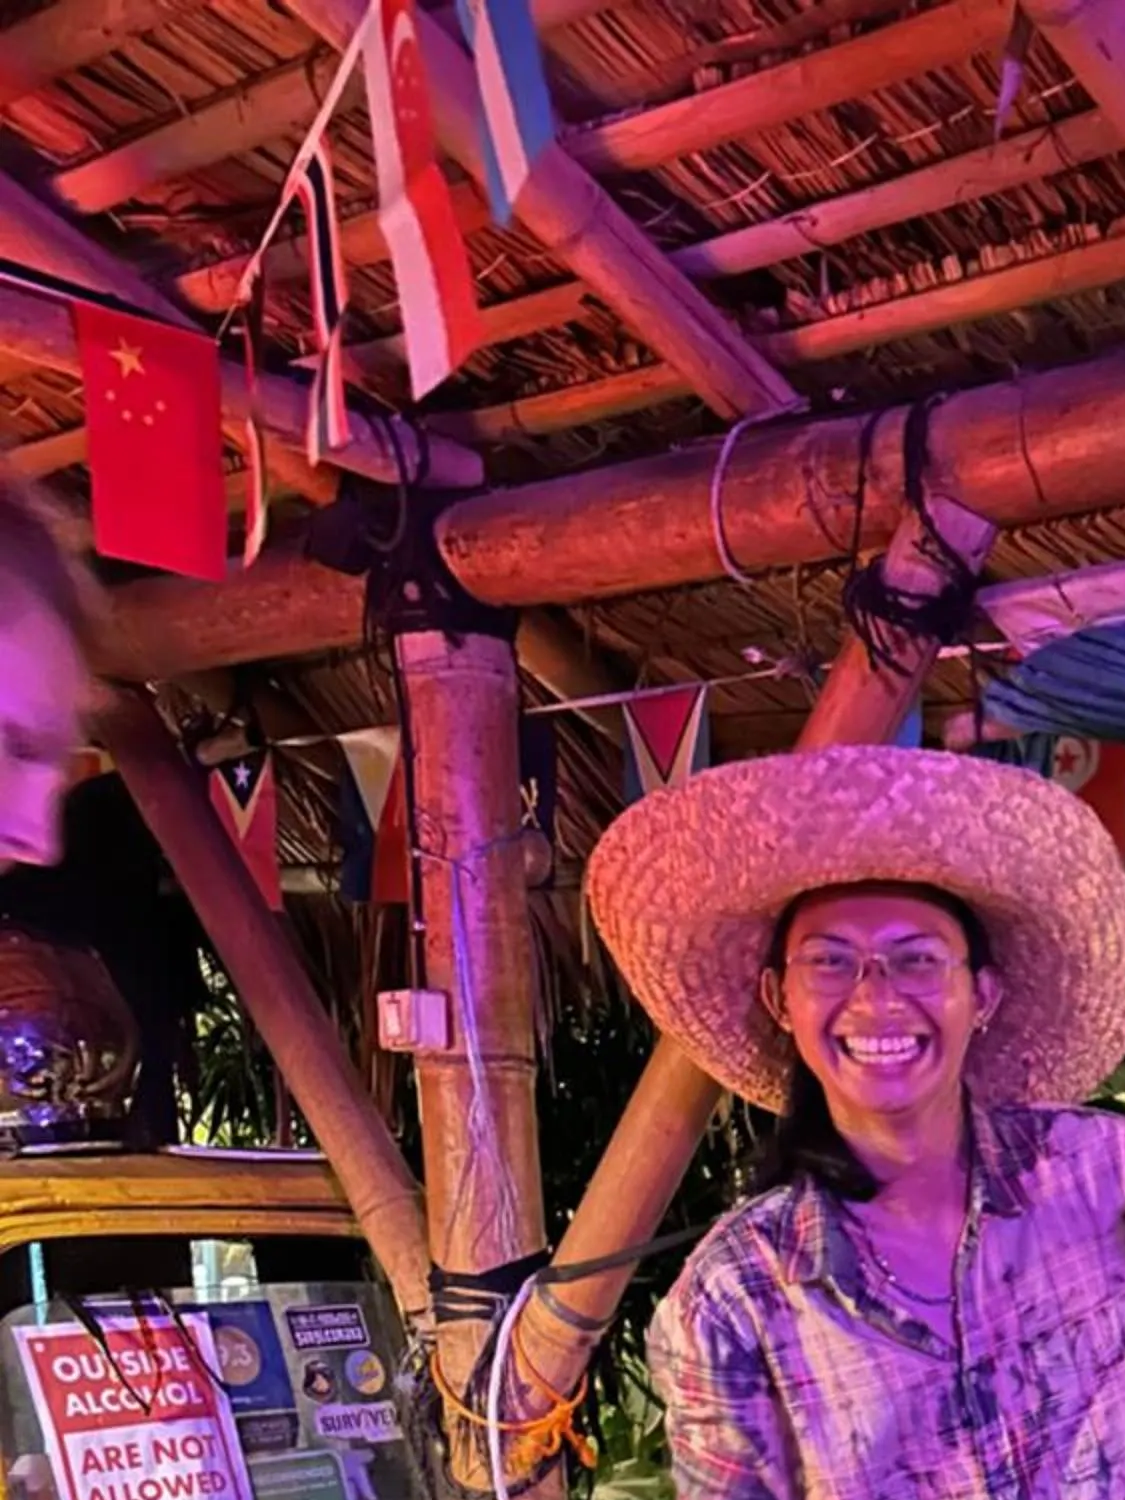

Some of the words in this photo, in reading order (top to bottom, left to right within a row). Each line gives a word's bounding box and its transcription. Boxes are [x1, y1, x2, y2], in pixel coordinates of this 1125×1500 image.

[52, 1347, 190, 1383] OUTSIDE
[65, 1380, 203, 1417] ALCOHOL
[81, 1442, 143, 1475] ARE
[151, 1433, 218, 1465] NOT
